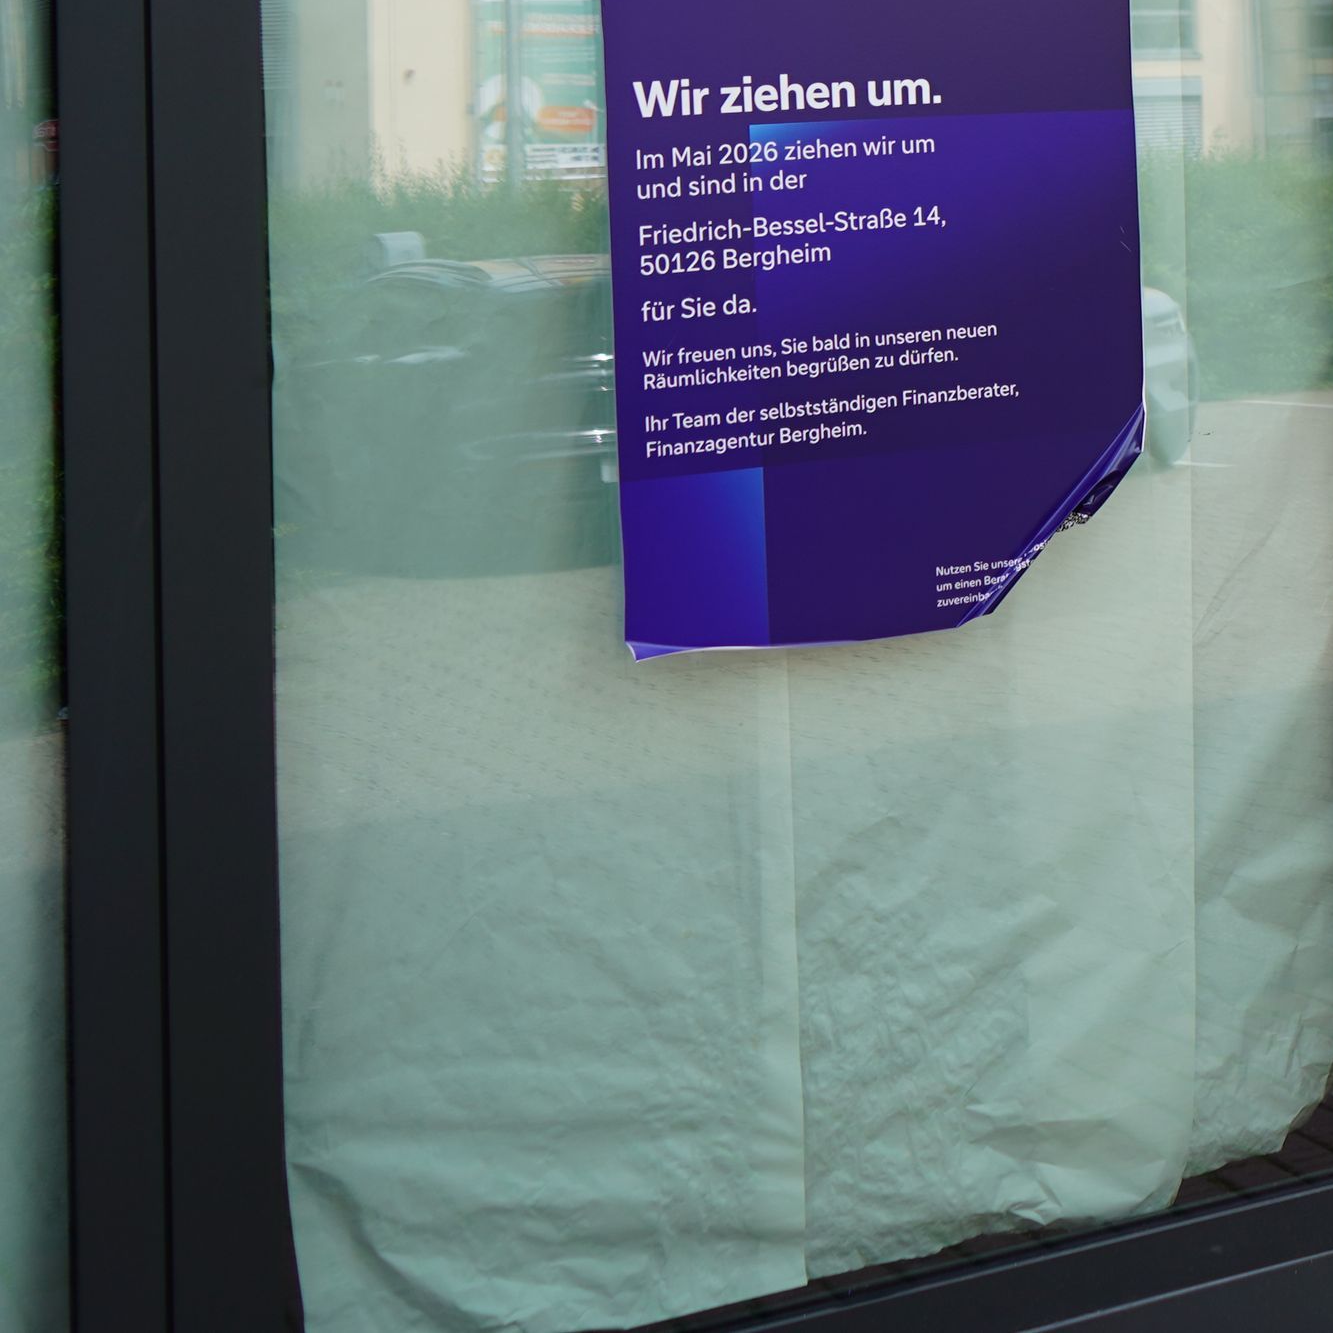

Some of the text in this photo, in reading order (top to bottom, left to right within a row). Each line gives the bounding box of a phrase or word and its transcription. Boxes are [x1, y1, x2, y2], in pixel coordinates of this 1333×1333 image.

[633, 74, 942, 118] Wir ziehen um.
[636, 135, 935, 170] Im Mai 2026 ziehen wir um
[636, 169, 807, 200] und sind in der
[639, 206, 947, 247] Friedrich-Bessel-Straße 14,
[640, 245, 831, 276] 50126 Bergheim
[642, 294, 757, 322] für Sie da.
[642, 321, 997, 367] Wir freuen uns, Sie bald in unseren neuen
[643, 346, 958, 390] Räumlichkeiten begrüßen zu dürfen.
[645, 380, 1019, 433] Ihr Team der selbstständigen Finanzberater,
[646, 420, 866, 458] Finanzagentur Bergheim.
[936, 564, 971, 576] Nutzen
[974, 559, 989, 571] Sie
[936, 582, 952, 592] um
[955, 578, 981, 589] einen
